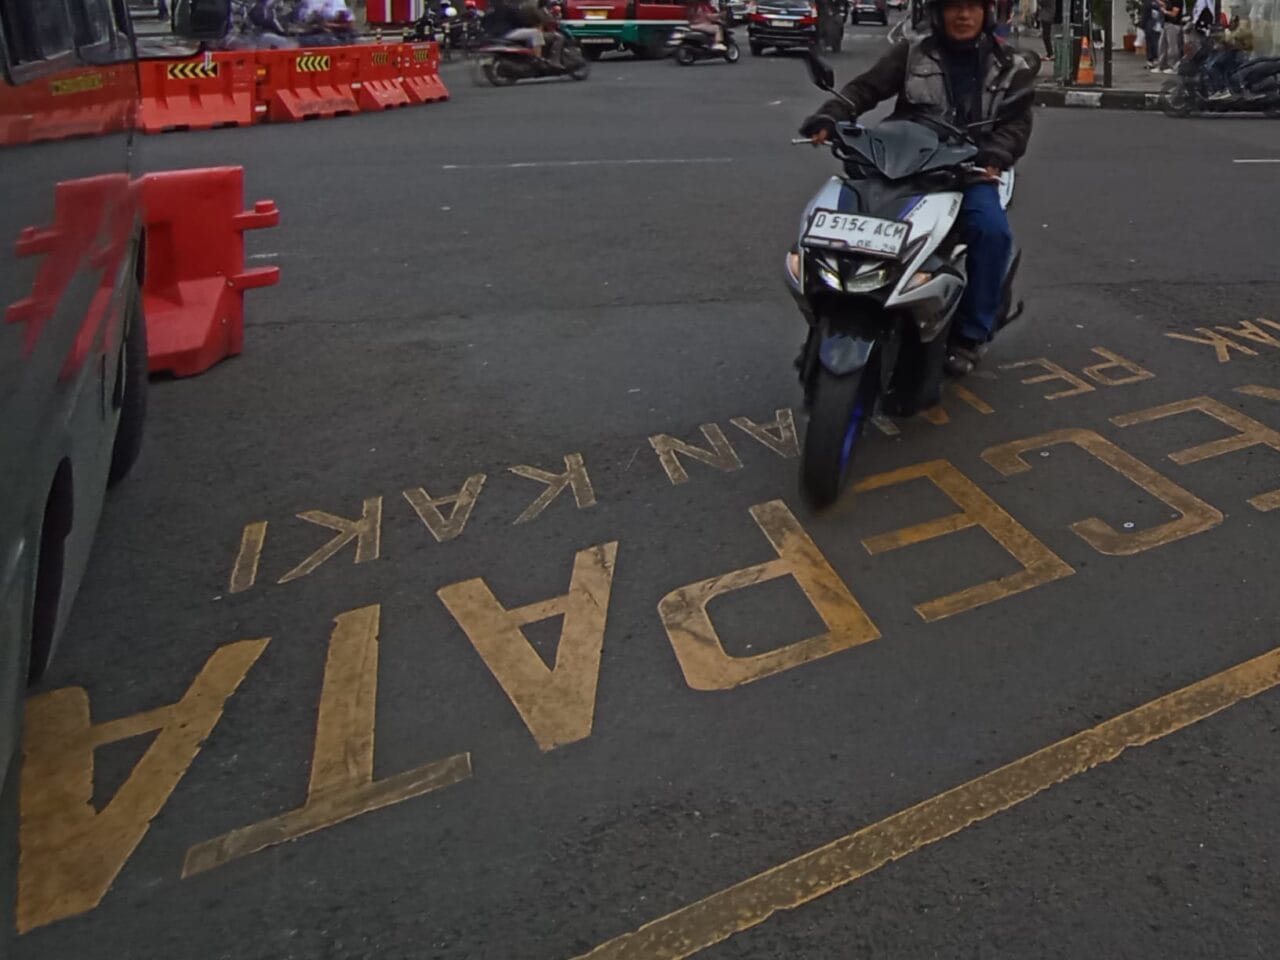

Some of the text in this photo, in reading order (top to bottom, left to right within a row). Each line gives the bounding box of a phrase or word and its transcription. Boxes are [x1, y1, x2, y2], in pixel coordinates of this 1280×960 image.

[815, 214, 827, 228] D
[873, 222, 905, 238] ACM
[229, 452, 597, 594] KAKI
